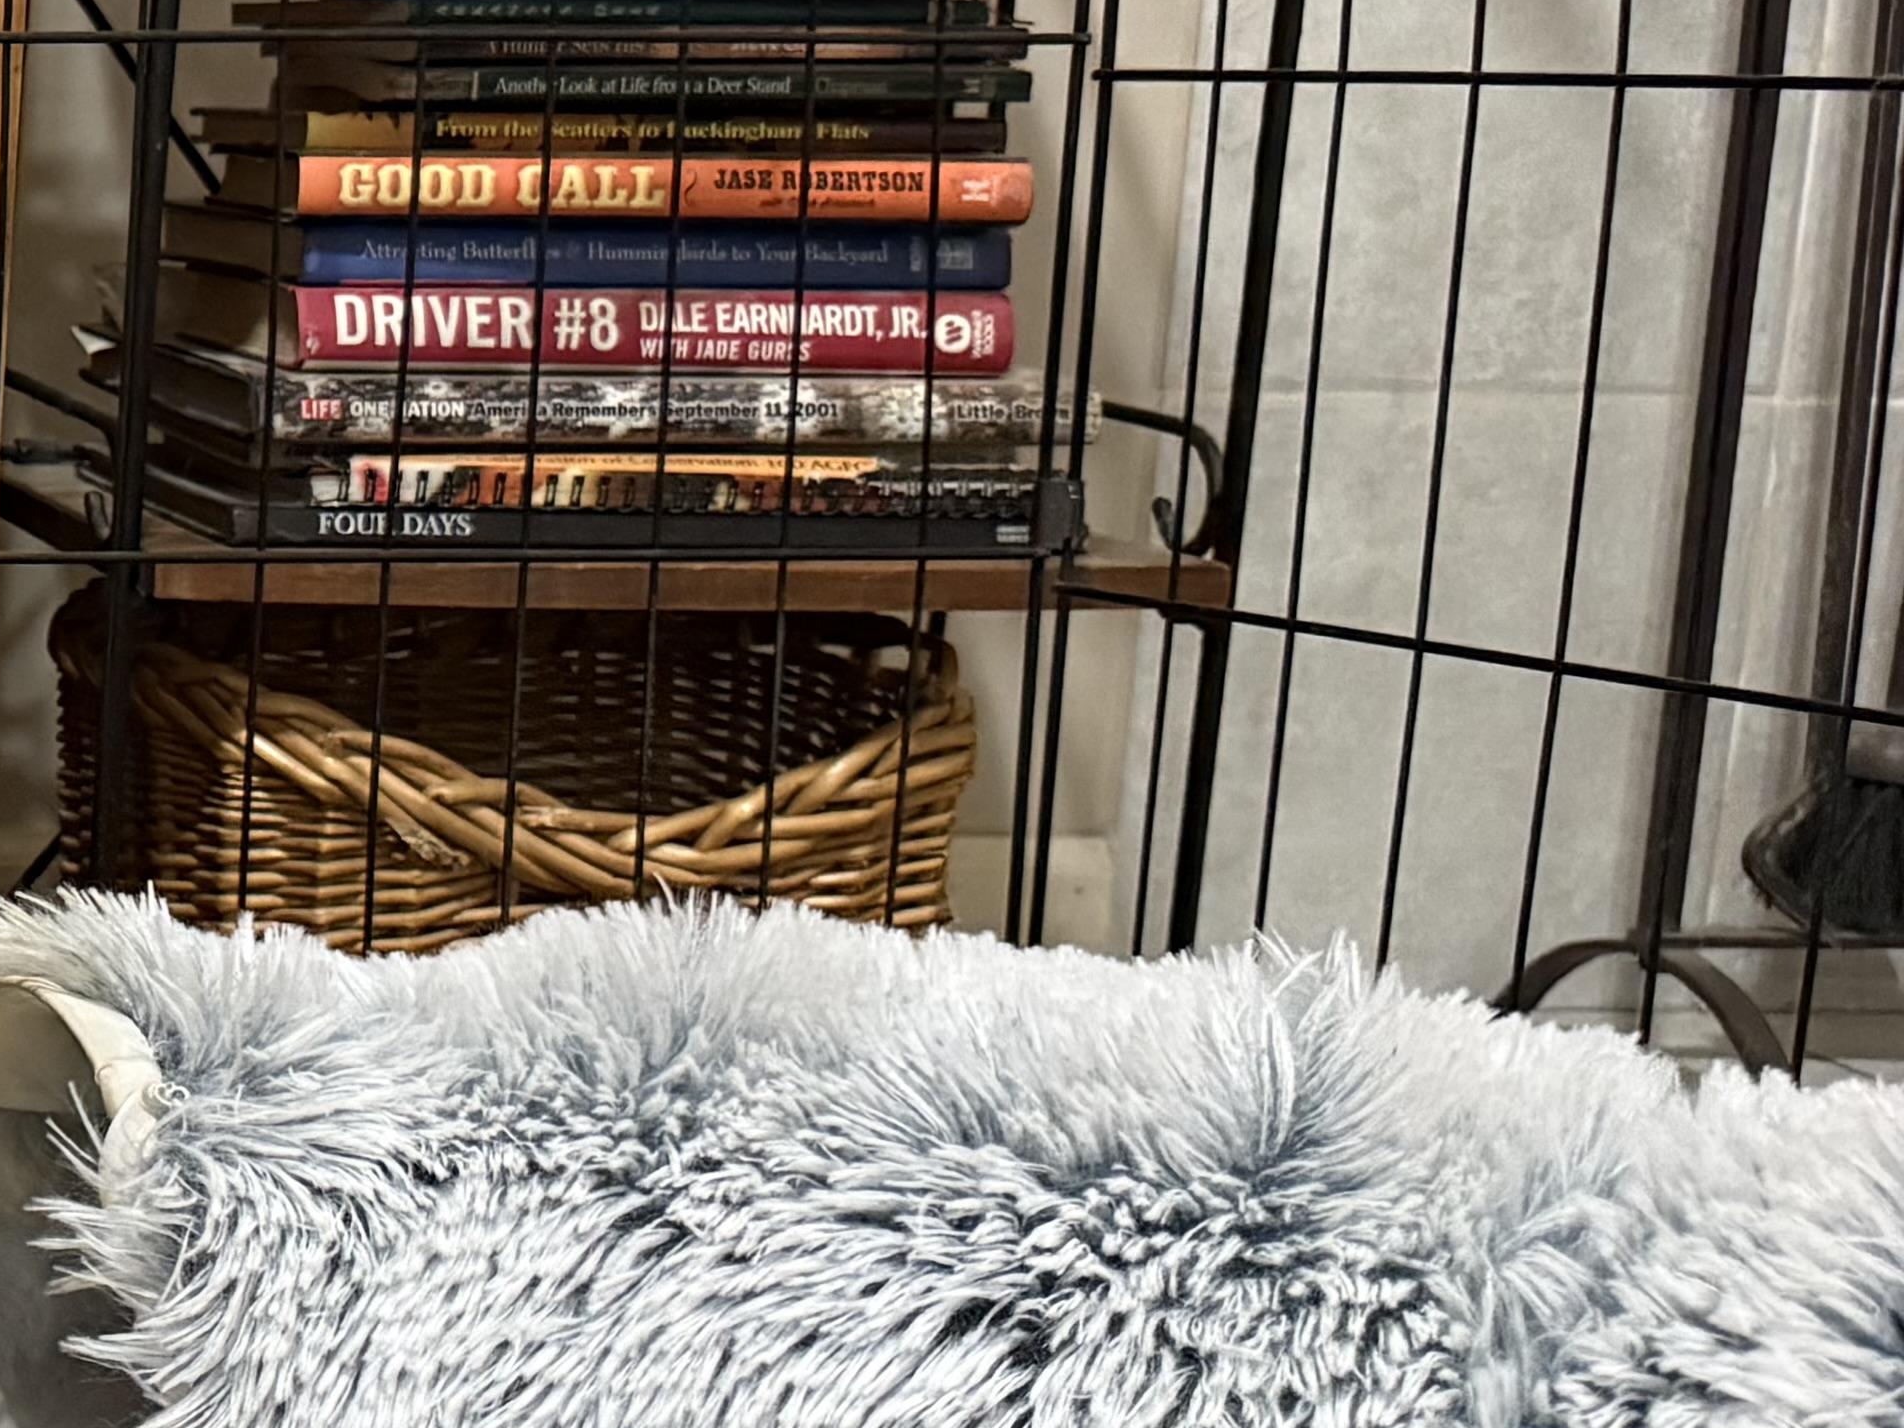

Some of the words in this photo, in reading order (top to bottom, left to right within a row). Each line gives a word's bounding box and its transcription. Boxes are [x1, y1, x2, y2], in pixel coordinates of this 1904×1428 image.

[495, 76, 558, 94] Anoth
[559, 75, 600, 94] Look
[602, 79, 616, 94] at
[619, 75, 650, 94] Life
[693, 80, 703, 94] a
[707, 76, 743, 96] Deer
[746, 75, 791, 95] Stand
[436, 120, 497, 138] From
[504, 120, 539, 138] the
[642, 121, 661, 139] to
[816, 122, 871, 140] Flats
[338, 162, 497, 209] GOOD
[515, 164, 666, 209] CALL
[714, 168, 773, 191] JASE
[463, 236, 561, 260] Butterfles
[731, 245, 751, 261] to
[754, 242, 796, 262] Your
[804, 241, 889, 265] Backyard
[333, 294, 534, 349] DRIVER
[553, 297, 620, 351] #8
[639, 301, 709, 333] DALE
[716, 302, 884, 342] EARNHARDT,
[889, 307, 928, 339] JR.
[639, 338, 689, 360] WIH
[694, 339, 740, 361] JADE
[301, 399, 342, 420] LIFE
[349, 399, 389, 418] ONE
[473, 401, 548, 419] Ameria
[552, 401, 657, 422] Remembers
[666, 401, 759, 422] September
[794, 403, 838, 418] 2001
[1014, 404, 1070, 419] Bron
[402, 513, 472, 536] DAYS
